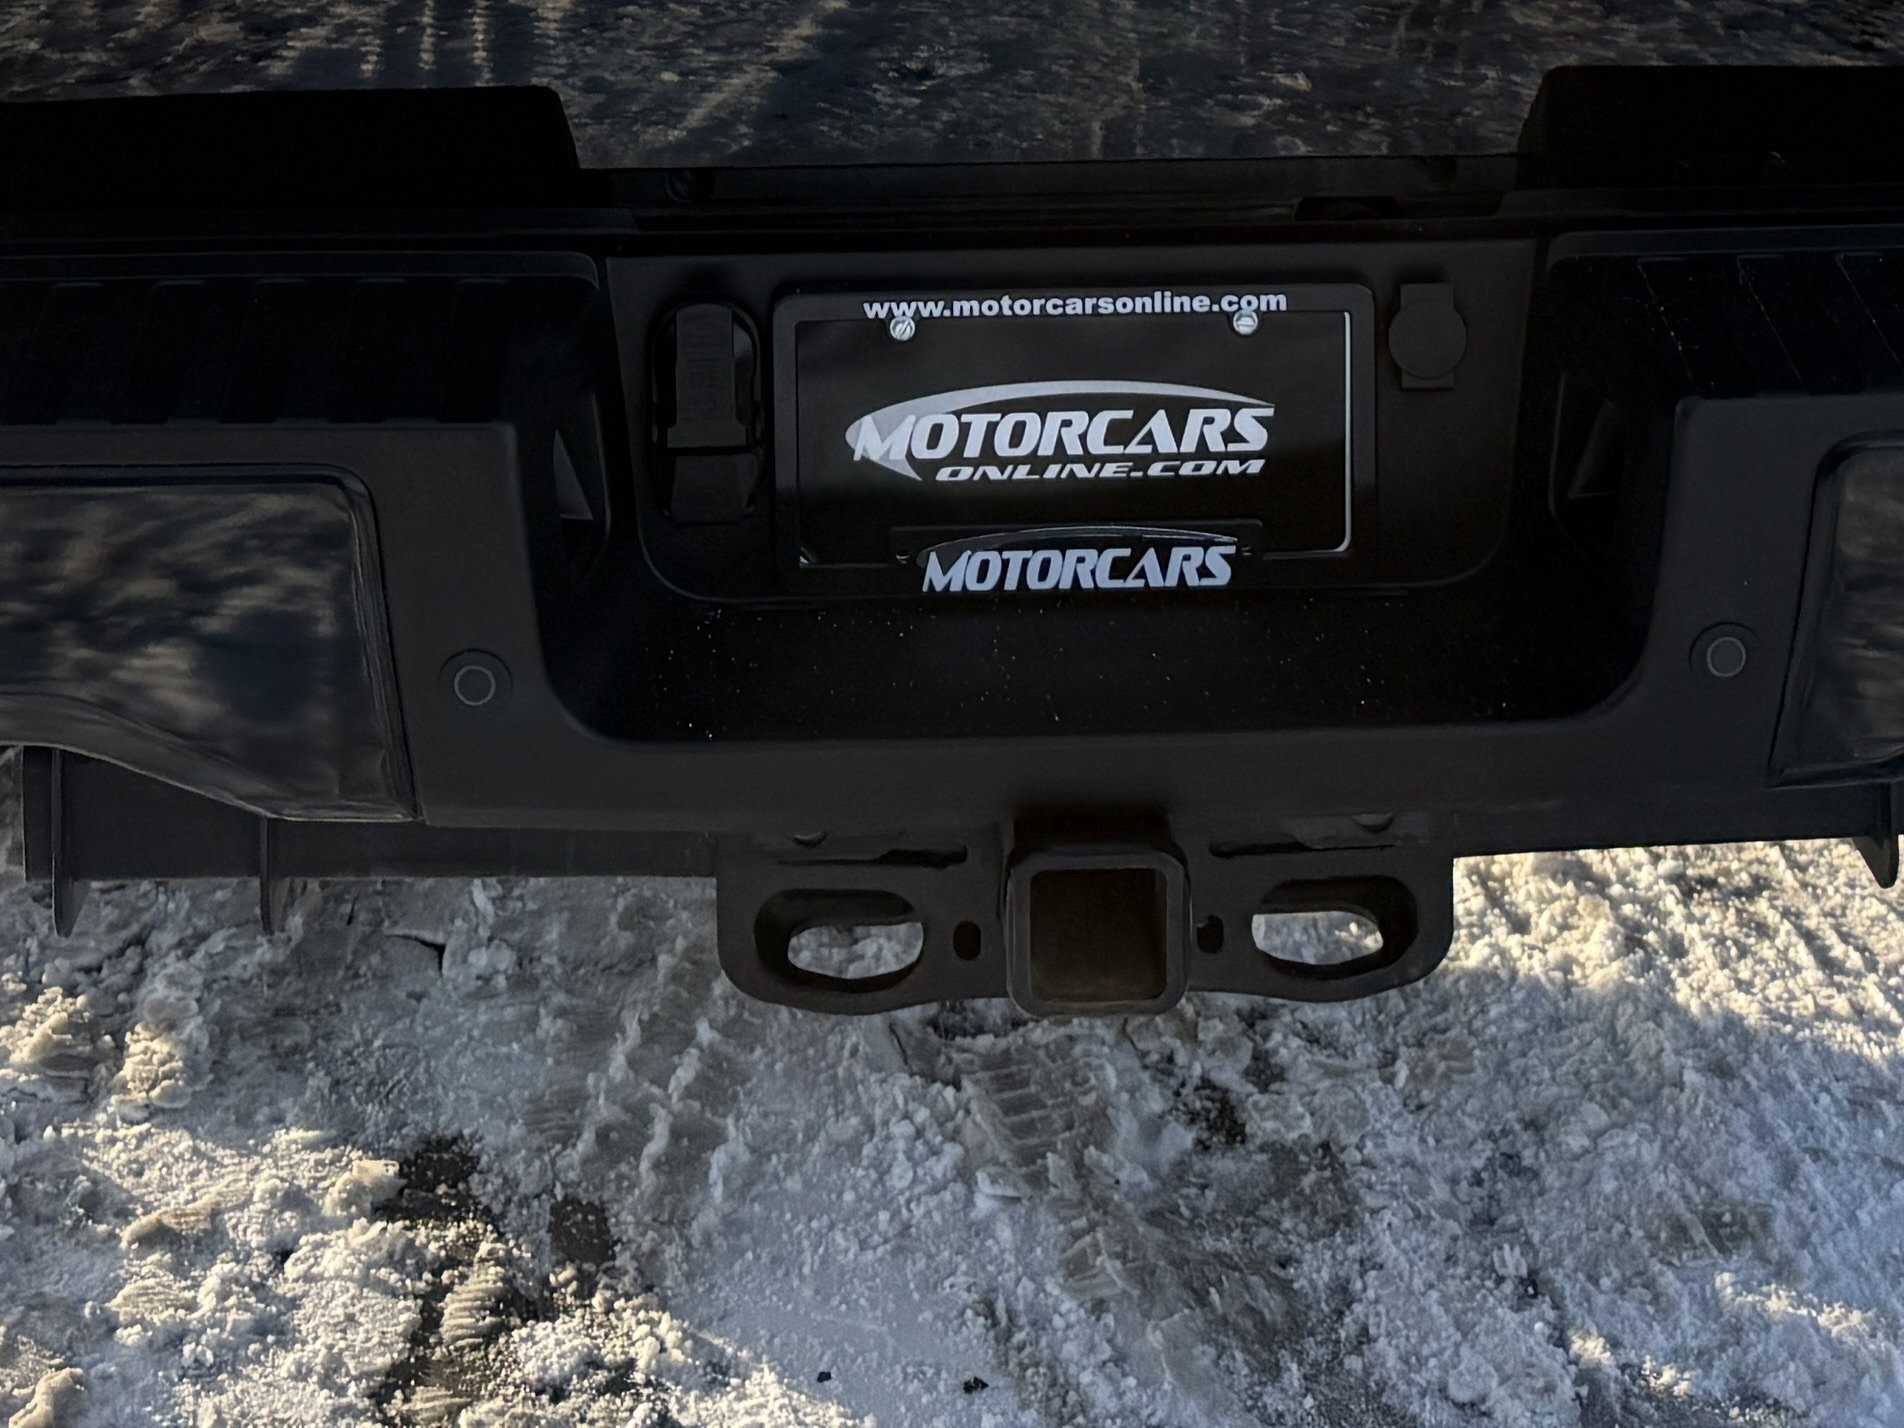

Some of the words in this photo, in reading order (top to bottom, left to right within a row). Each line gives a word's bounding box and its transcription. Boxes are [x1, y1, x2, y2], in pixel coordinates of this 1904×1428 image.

[863, 290, 1287, 319] www.motorcarsonline.com
[853, 407, 1275, 461] MOTORCARS
[935, 458, 1266, 482] ONLINE.COM
[921, 544, 1237, 593] MOTORCARS
